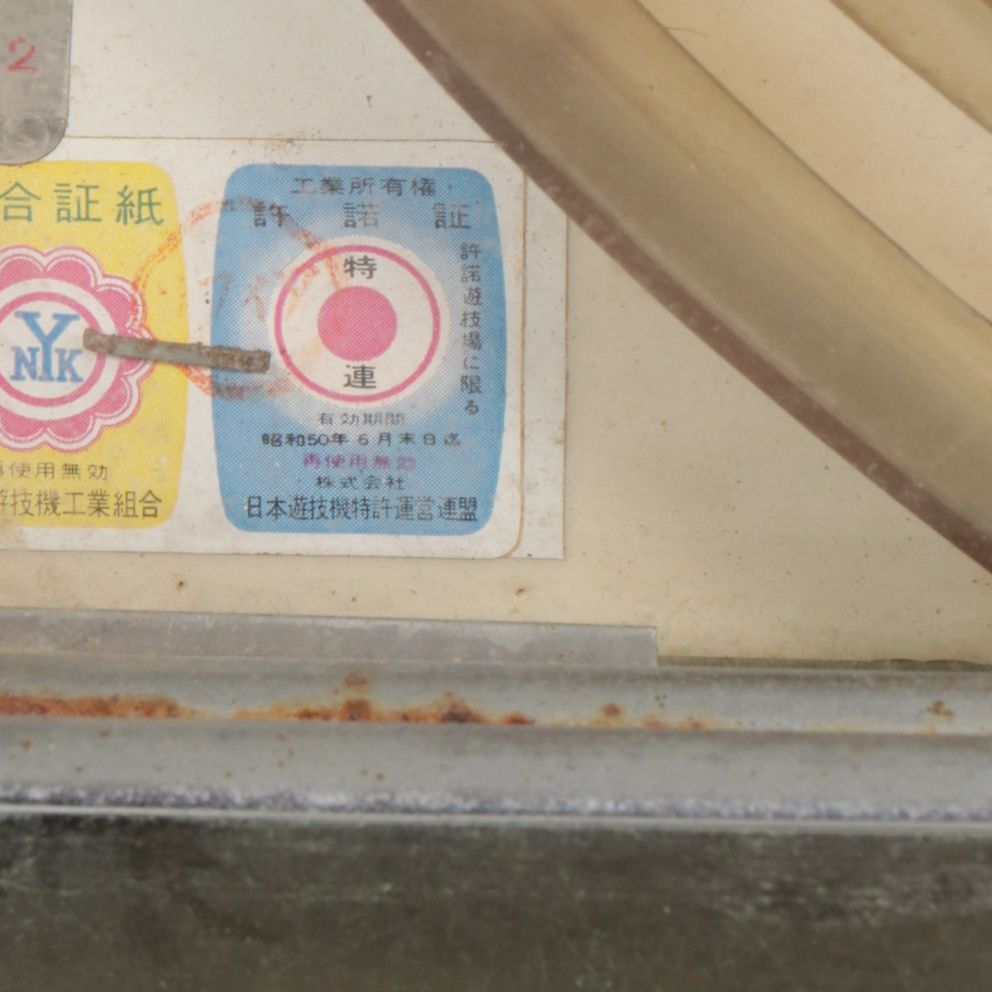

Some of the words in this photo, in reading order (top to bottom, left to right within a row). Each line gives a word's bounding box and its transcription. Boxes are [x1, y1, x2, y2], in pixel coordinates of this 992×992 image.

[344, 255, 378, 280] 特
[344, 364, 378, 390] 連
[315, 475, 405, 490] 株式会社
